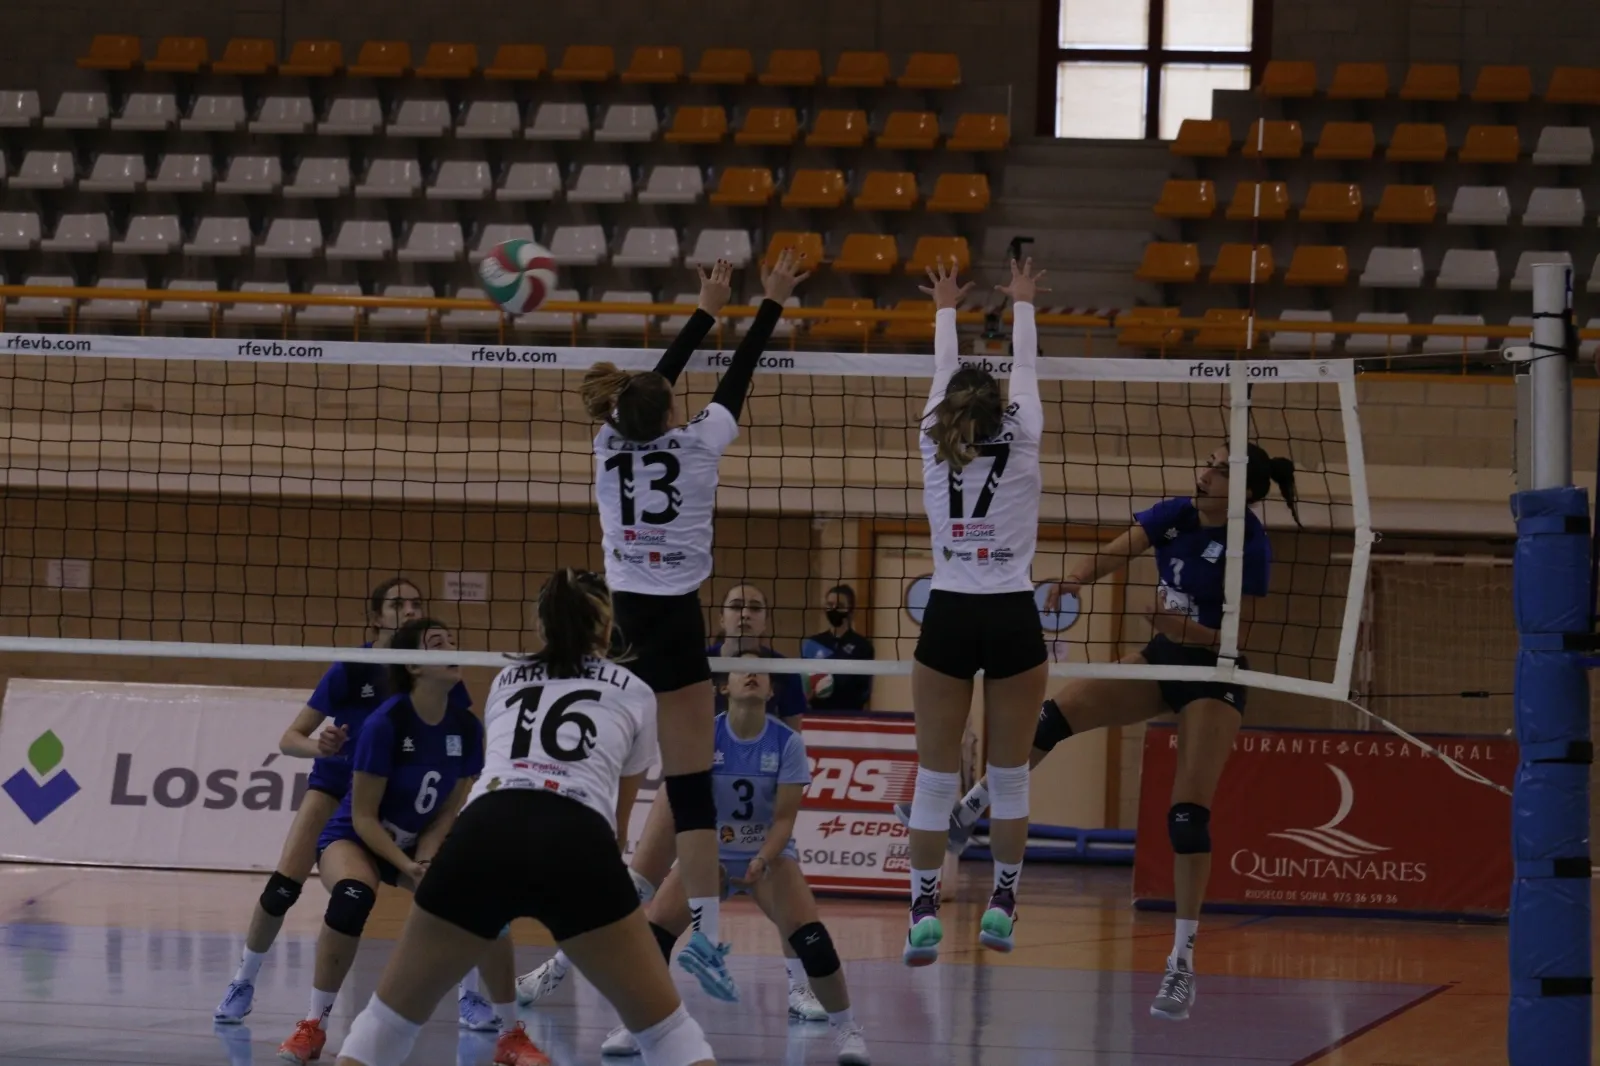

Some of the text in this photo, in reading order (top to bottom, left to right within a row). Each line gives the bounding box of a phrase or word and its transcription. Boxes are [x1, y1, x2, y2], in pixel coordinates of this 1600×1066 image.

[7, 335, 91, 351] rfevb.com
[238, 341, 323, 357] rfevb.com
[471, 346, 557, 363] rfevb.com
[604, 451, 683, 526] 13
[935, 442, 1010, 519] 17
[505, 685, 602, 762] 16
[1353, 740, 1411, 758] CASA
[413, 770, 443, 815] 6
[803, 756, 897, 803] AS
[731, 778, 755, 821] 3
[1230, 848, 1428, 884] QUINTANARES
[1285, 890, 1298, 901] DE
[1333, 891, 1351, 904] 975
